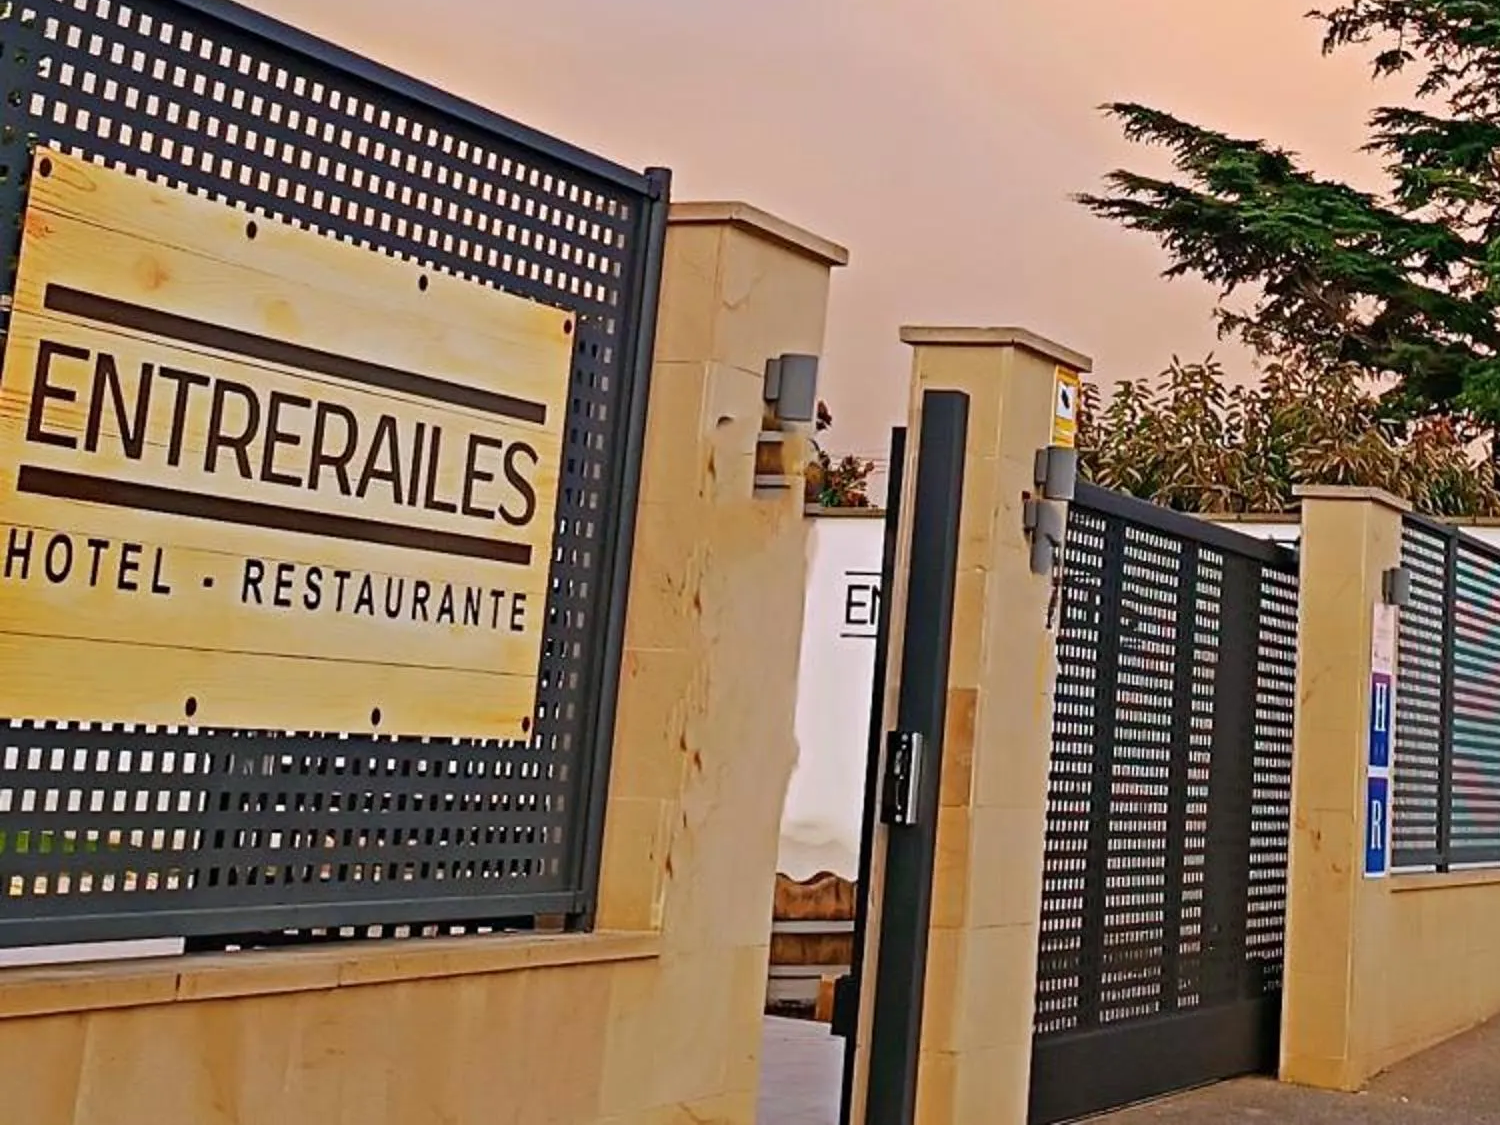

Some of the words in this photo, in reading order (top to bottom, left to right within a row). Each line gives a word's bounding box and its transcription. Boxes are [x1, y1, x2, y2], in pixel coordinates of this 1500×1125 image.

[26, 339, 538, 526] ENTRERAILES
[4, 529, 172, 595] HOTEL
[242, 559, 527, 632] RESTAURANTE
[1374, 682, 1387, 732] H
[1371, 799, 1383, 850] R
